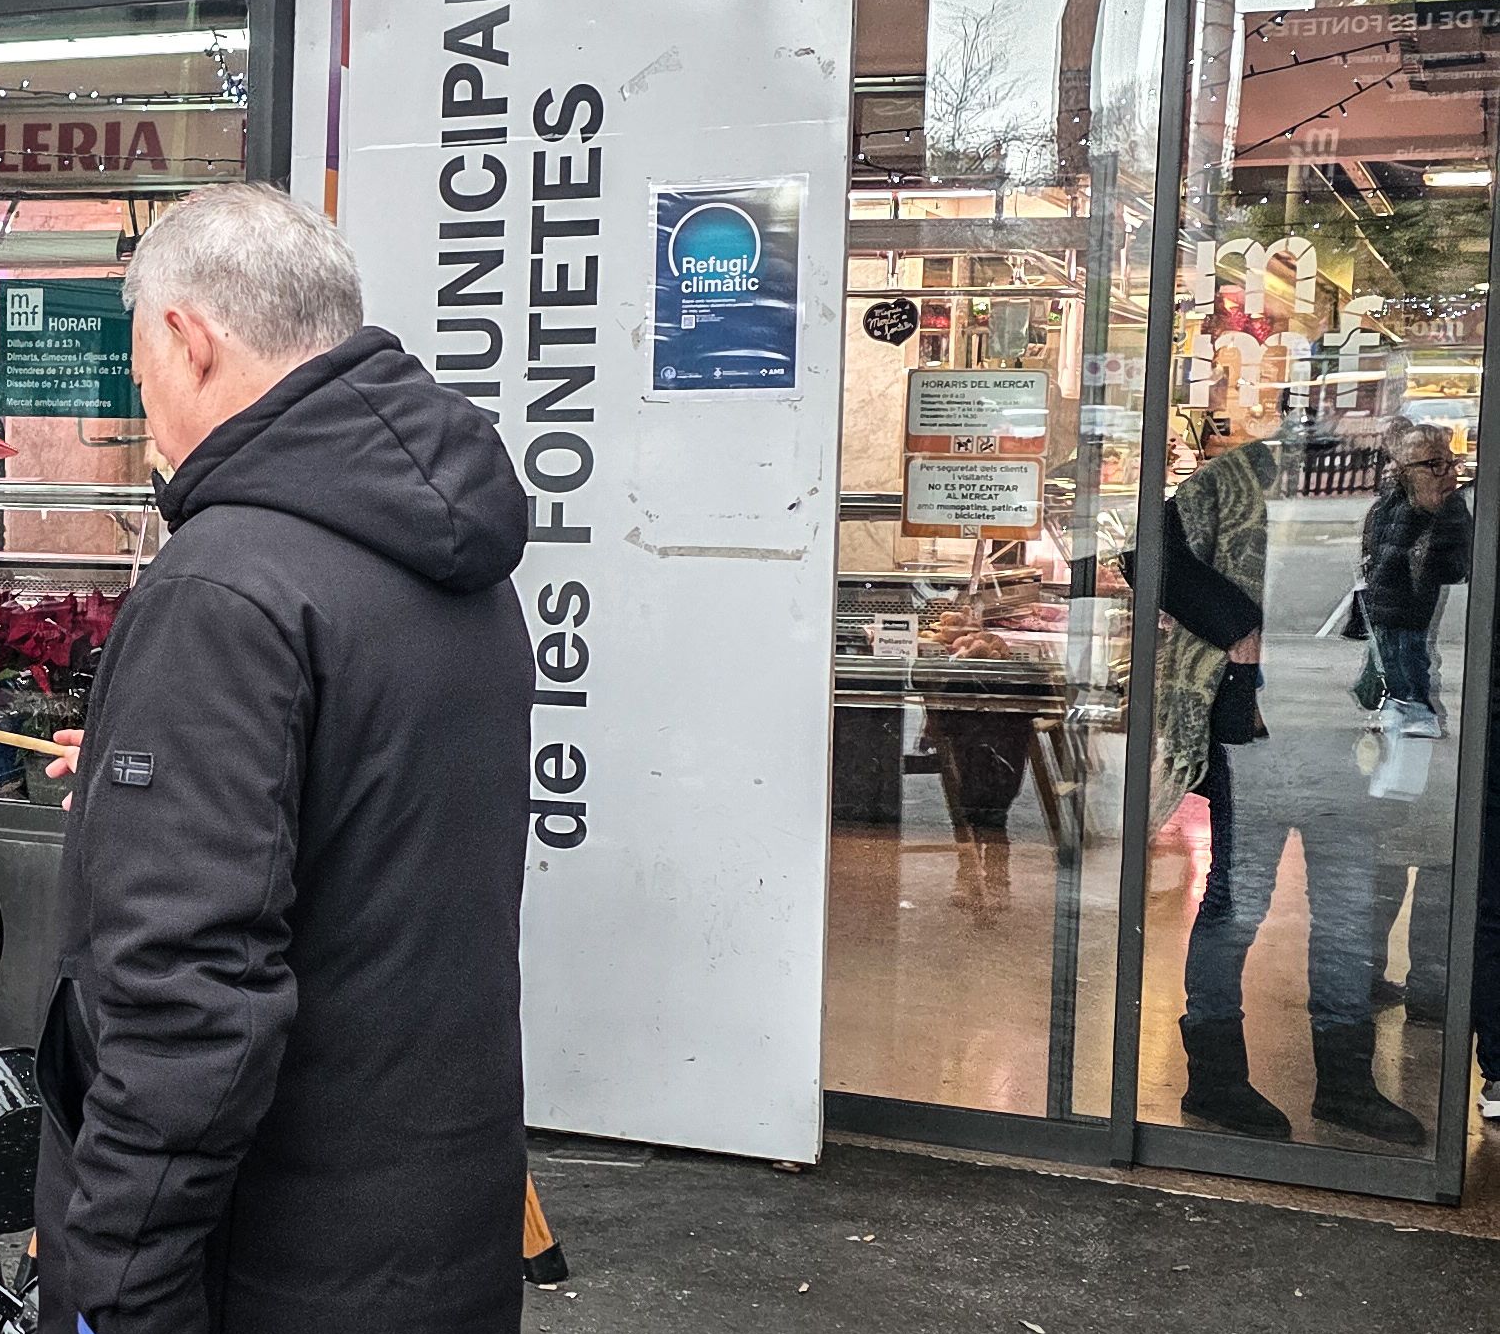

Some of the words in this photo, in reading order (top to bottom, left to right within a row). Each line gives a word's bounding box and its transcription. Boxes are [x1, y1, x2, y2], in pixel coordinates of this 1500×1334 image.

[682, 254, 748, 276] Refugi
[1194, 236, 1318, 315] m
[681, 273, 760, 294] climàtic
[11, 293, 29, 309] m
[10, 305, 39, 327] mf
[524, 83, 604, 544] FONTETES
[48, 317, 102, 332] HORARI
[6, 338, 34, 348] Dilluns
[35, 338, 45, 348] de
[46, 338, 53, 348] 8
[62, 338, 73, 348] 13
[75, 338, 81, 348] h
[1189, 295, 1385, 408] mf
[109, 352, 120, 363] de
[121, 352, 128, 363] 8
[6, 366, 45, 375] Divendres
[46, 366, 57, 375] de
[58, 366, 65, 375] 7
[65, 366, 72, 375] a
[73, 366, 85, 375] 14
[98, 366, 109, 375] de
[111, 366, 123, 375] 17
[6, 379, 40, 388] Dissabte
[41, 379, 52, 388] de
[53, 379, 59, 388] 7
[60, 379, 67, 388] a
[921, 380, 968, 389] HORARIS
[970, 380, 991, 389] DEL
[993, 380, 1036, 389] MERCAT
[6, 398, 33, 407] Mercat
[73, 398, 112, 407] divendres
[919, 463, 935, 473] Per
[936, 464, 978, 474] seguretat
[999, 464, 1028, 474] clients
[957, 472, 994, 482] visitants
[927, 483, 941, 491] NO
[958, 484, 977, 492] POT
[979, 484, 1019, 492] ENTRAR
[945, 492, 958, 500] AL
[960, 492, 1000, 501] MERCAT
[916, 502, 935, 511] amb
[954, 512, 996, 521] bicicletes
[532, 580, 590, 707] les
[530, 741, 587, 849] de
